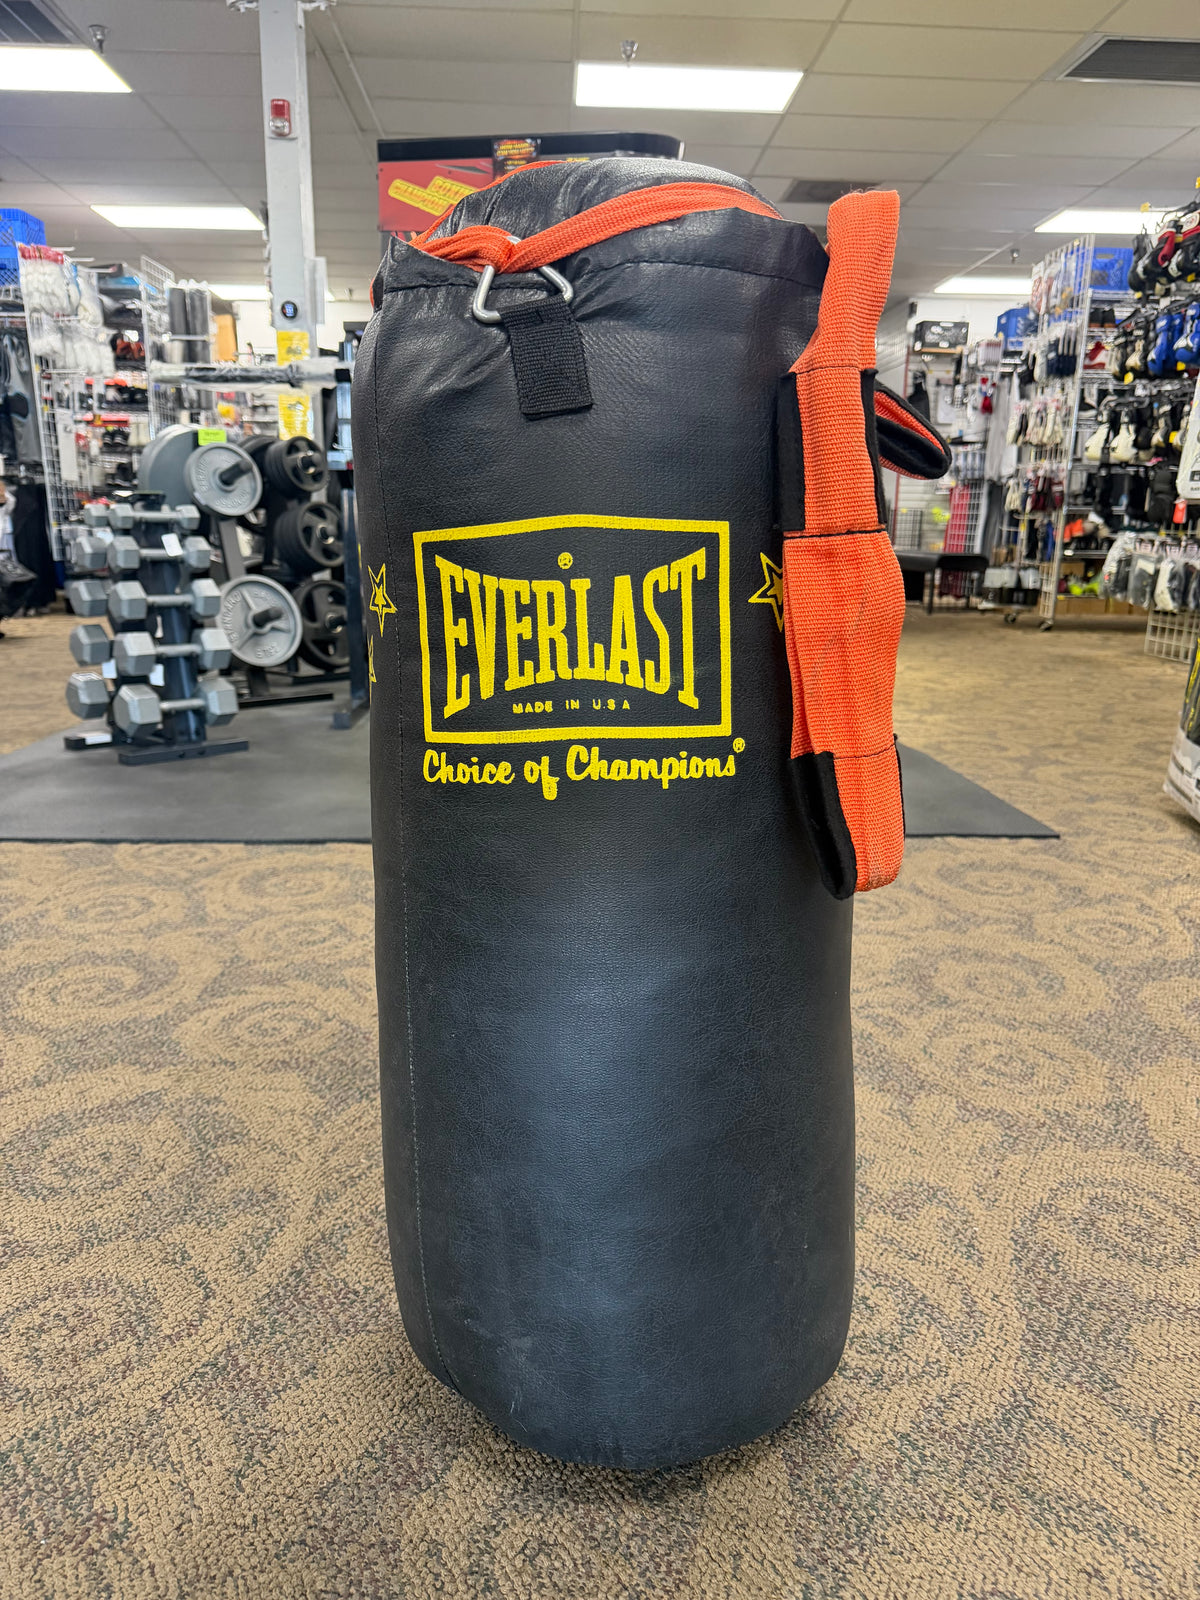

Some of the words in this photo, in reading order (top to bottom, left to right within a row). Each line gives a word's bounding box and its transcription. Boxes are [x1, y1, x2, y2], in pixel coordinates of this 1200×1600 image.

[435, 547, 706, 719] EVERLAST
[512, 701, 553, 713] MADE
[565, 700, 580, 710] IN
[423, 749, 516, 784] Choice
[524, 756, 560, 800] of
